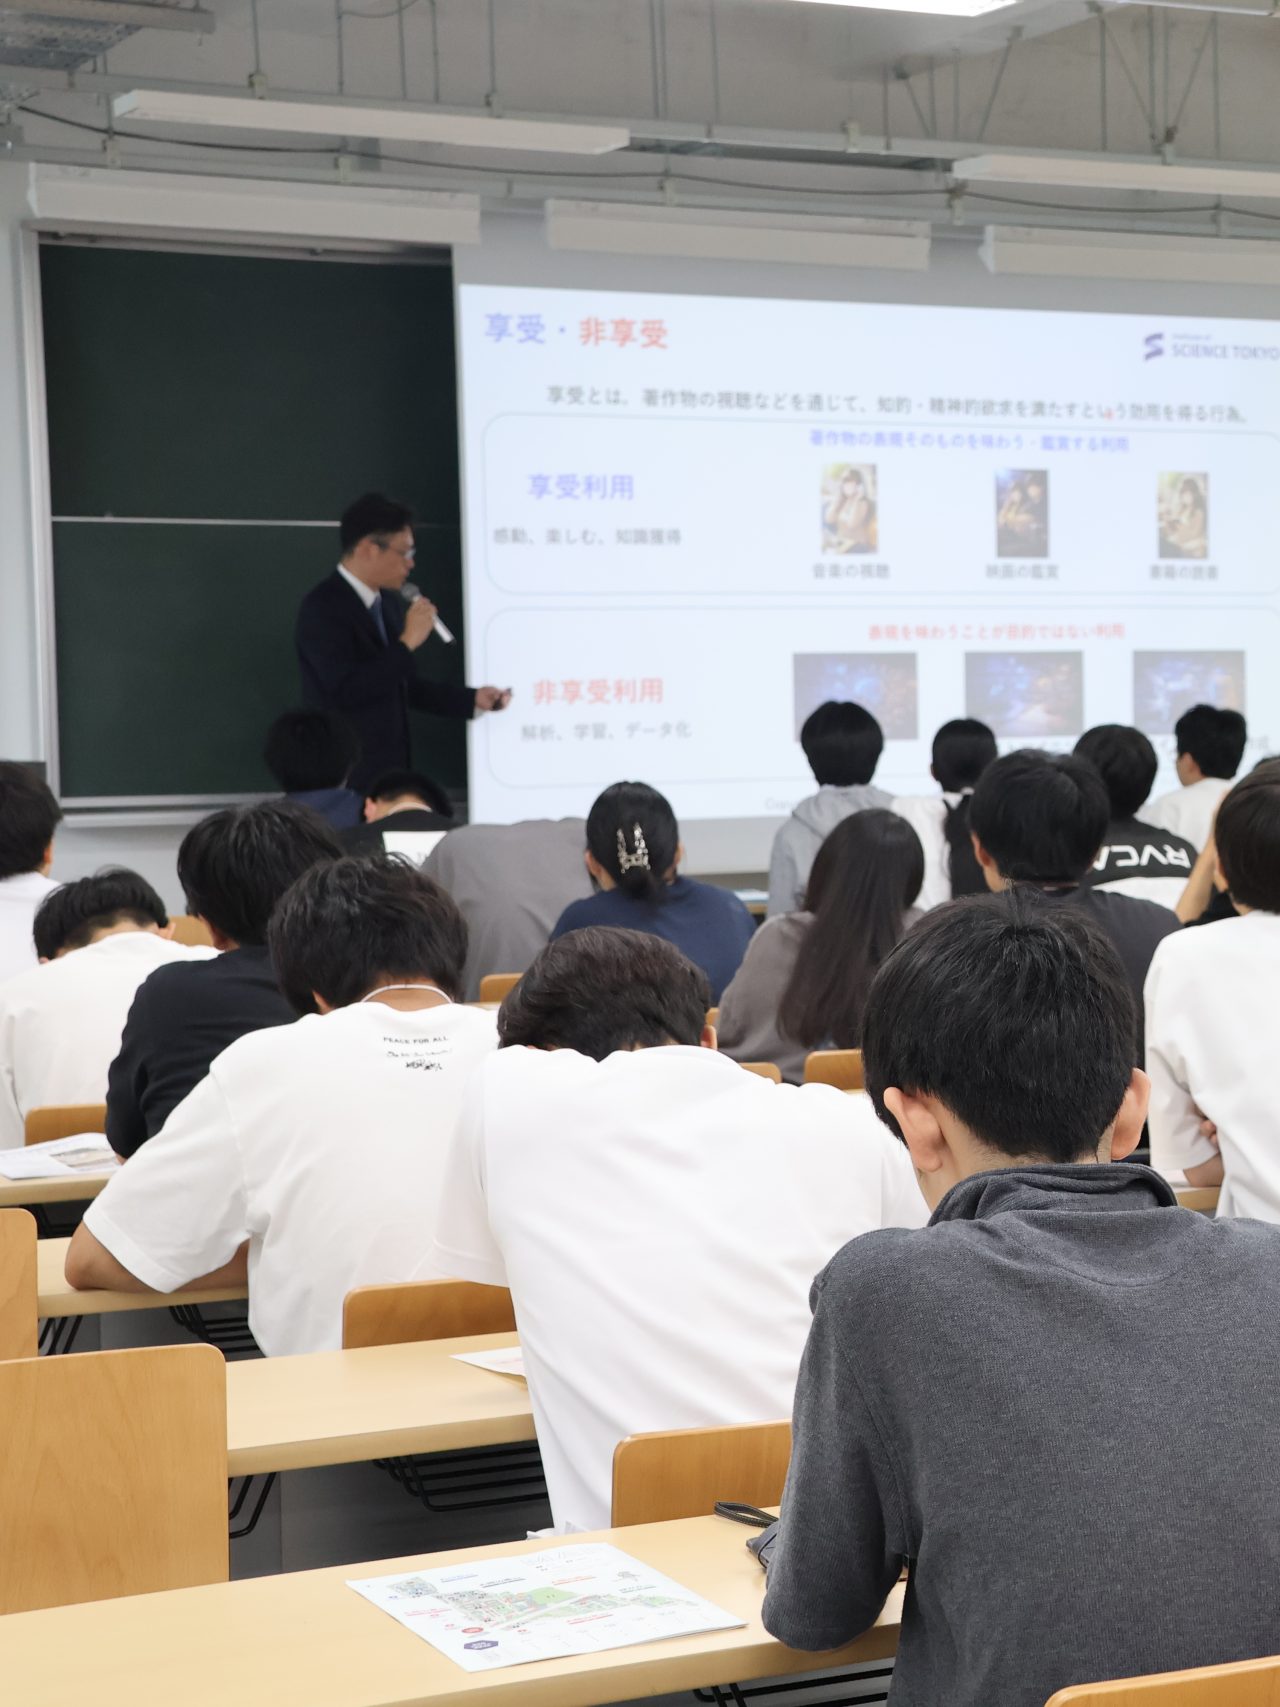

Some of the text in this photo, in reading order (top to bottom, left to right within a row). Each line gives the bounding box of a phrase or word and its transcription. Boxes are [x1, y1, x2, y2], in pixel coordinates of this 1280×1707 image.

[484, 312, 669, 349] 享受・非享受
[1171, 342, 1280, 361] SCIENCE TOKYO
[527, 472, 635, 501] 享受利用
[532, 676, 665, 705] 非享受利用
[520, 720, 692, 742] 解析、学習、データ化
